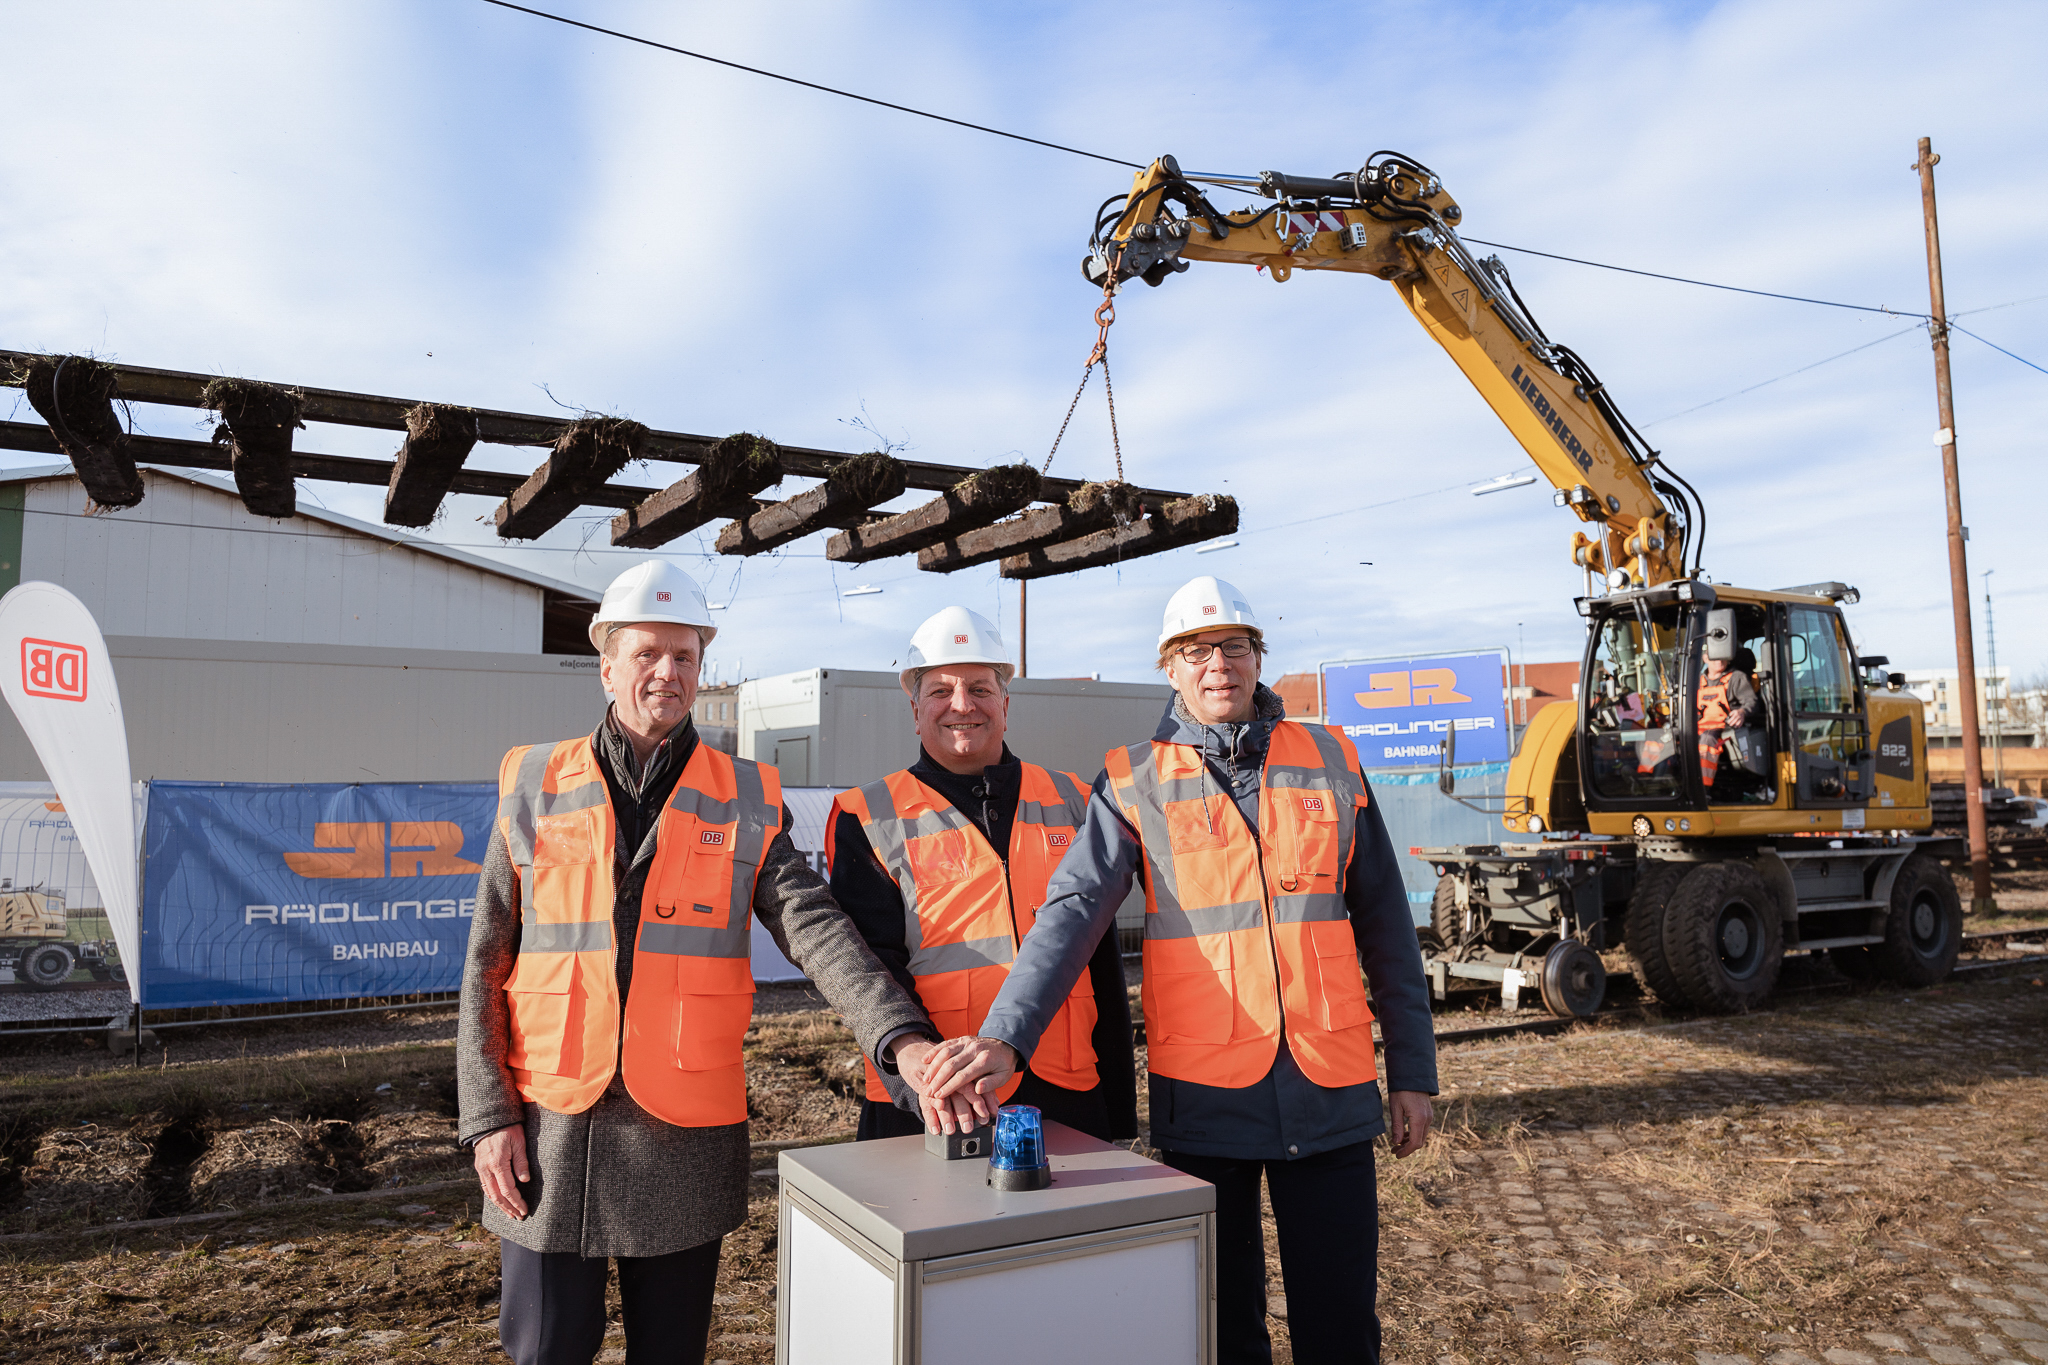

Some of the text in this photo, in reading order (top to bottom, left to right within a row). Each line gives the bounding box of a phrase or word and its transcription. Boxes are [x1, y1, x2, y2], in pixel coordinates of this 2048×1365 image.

[1511, 364, 1593, 474] LIEBHERR
[658, 593, 670, 601] DB
[1204, 606, 1216, 614] DB
[1342, 716, 1495, 737] RÄDLINGER
[1882, 744, 1906, 757] 922
[1304, 799, 1321, 809] DB
[702, 832, 722, 844] DB
[1050, 835, 1067, 845] DB
[245, 898, 476, 925] RÄDLINGE
[333, 940, 439, 960] BAHNBAU
